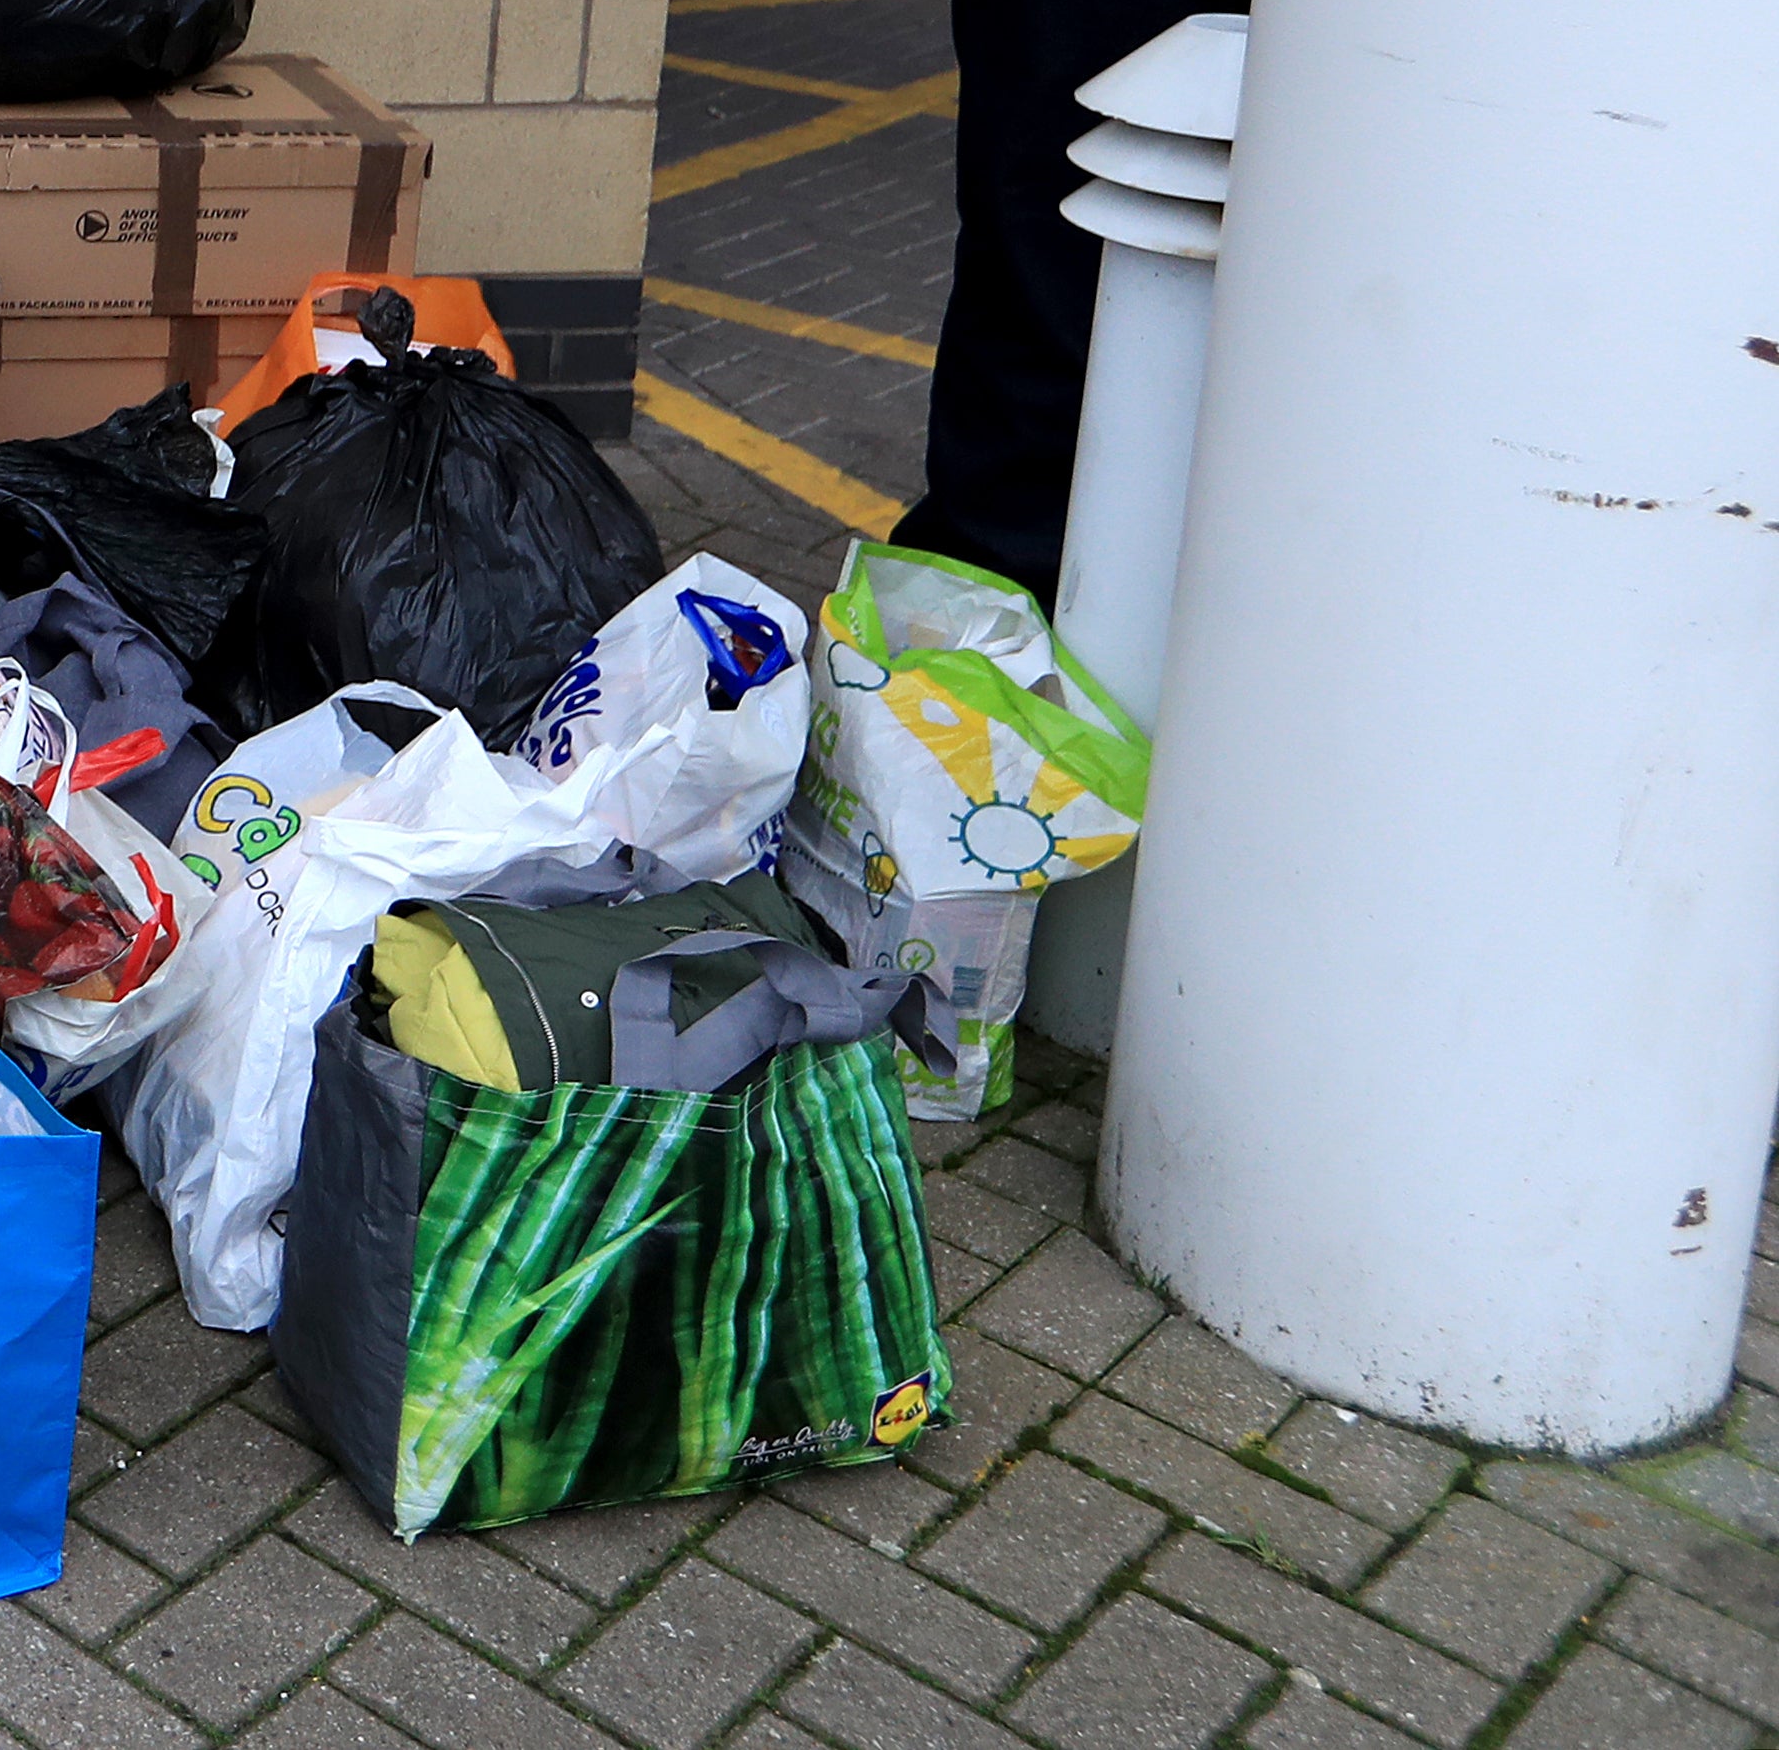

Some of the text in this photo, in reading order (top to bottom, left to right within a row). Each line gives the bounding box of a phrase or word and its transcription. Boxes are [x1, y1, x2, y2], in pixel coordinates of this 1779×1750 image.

[118, 220, 136, 231] OF
[18, 300, 85, 310] PACKAGING
[88, 300, 101, 310] IS
[102, 300, 136, 310] MADE
[205, 299, 266, 309] RECYCLED
[776, 1450, 796, 1460] ON
